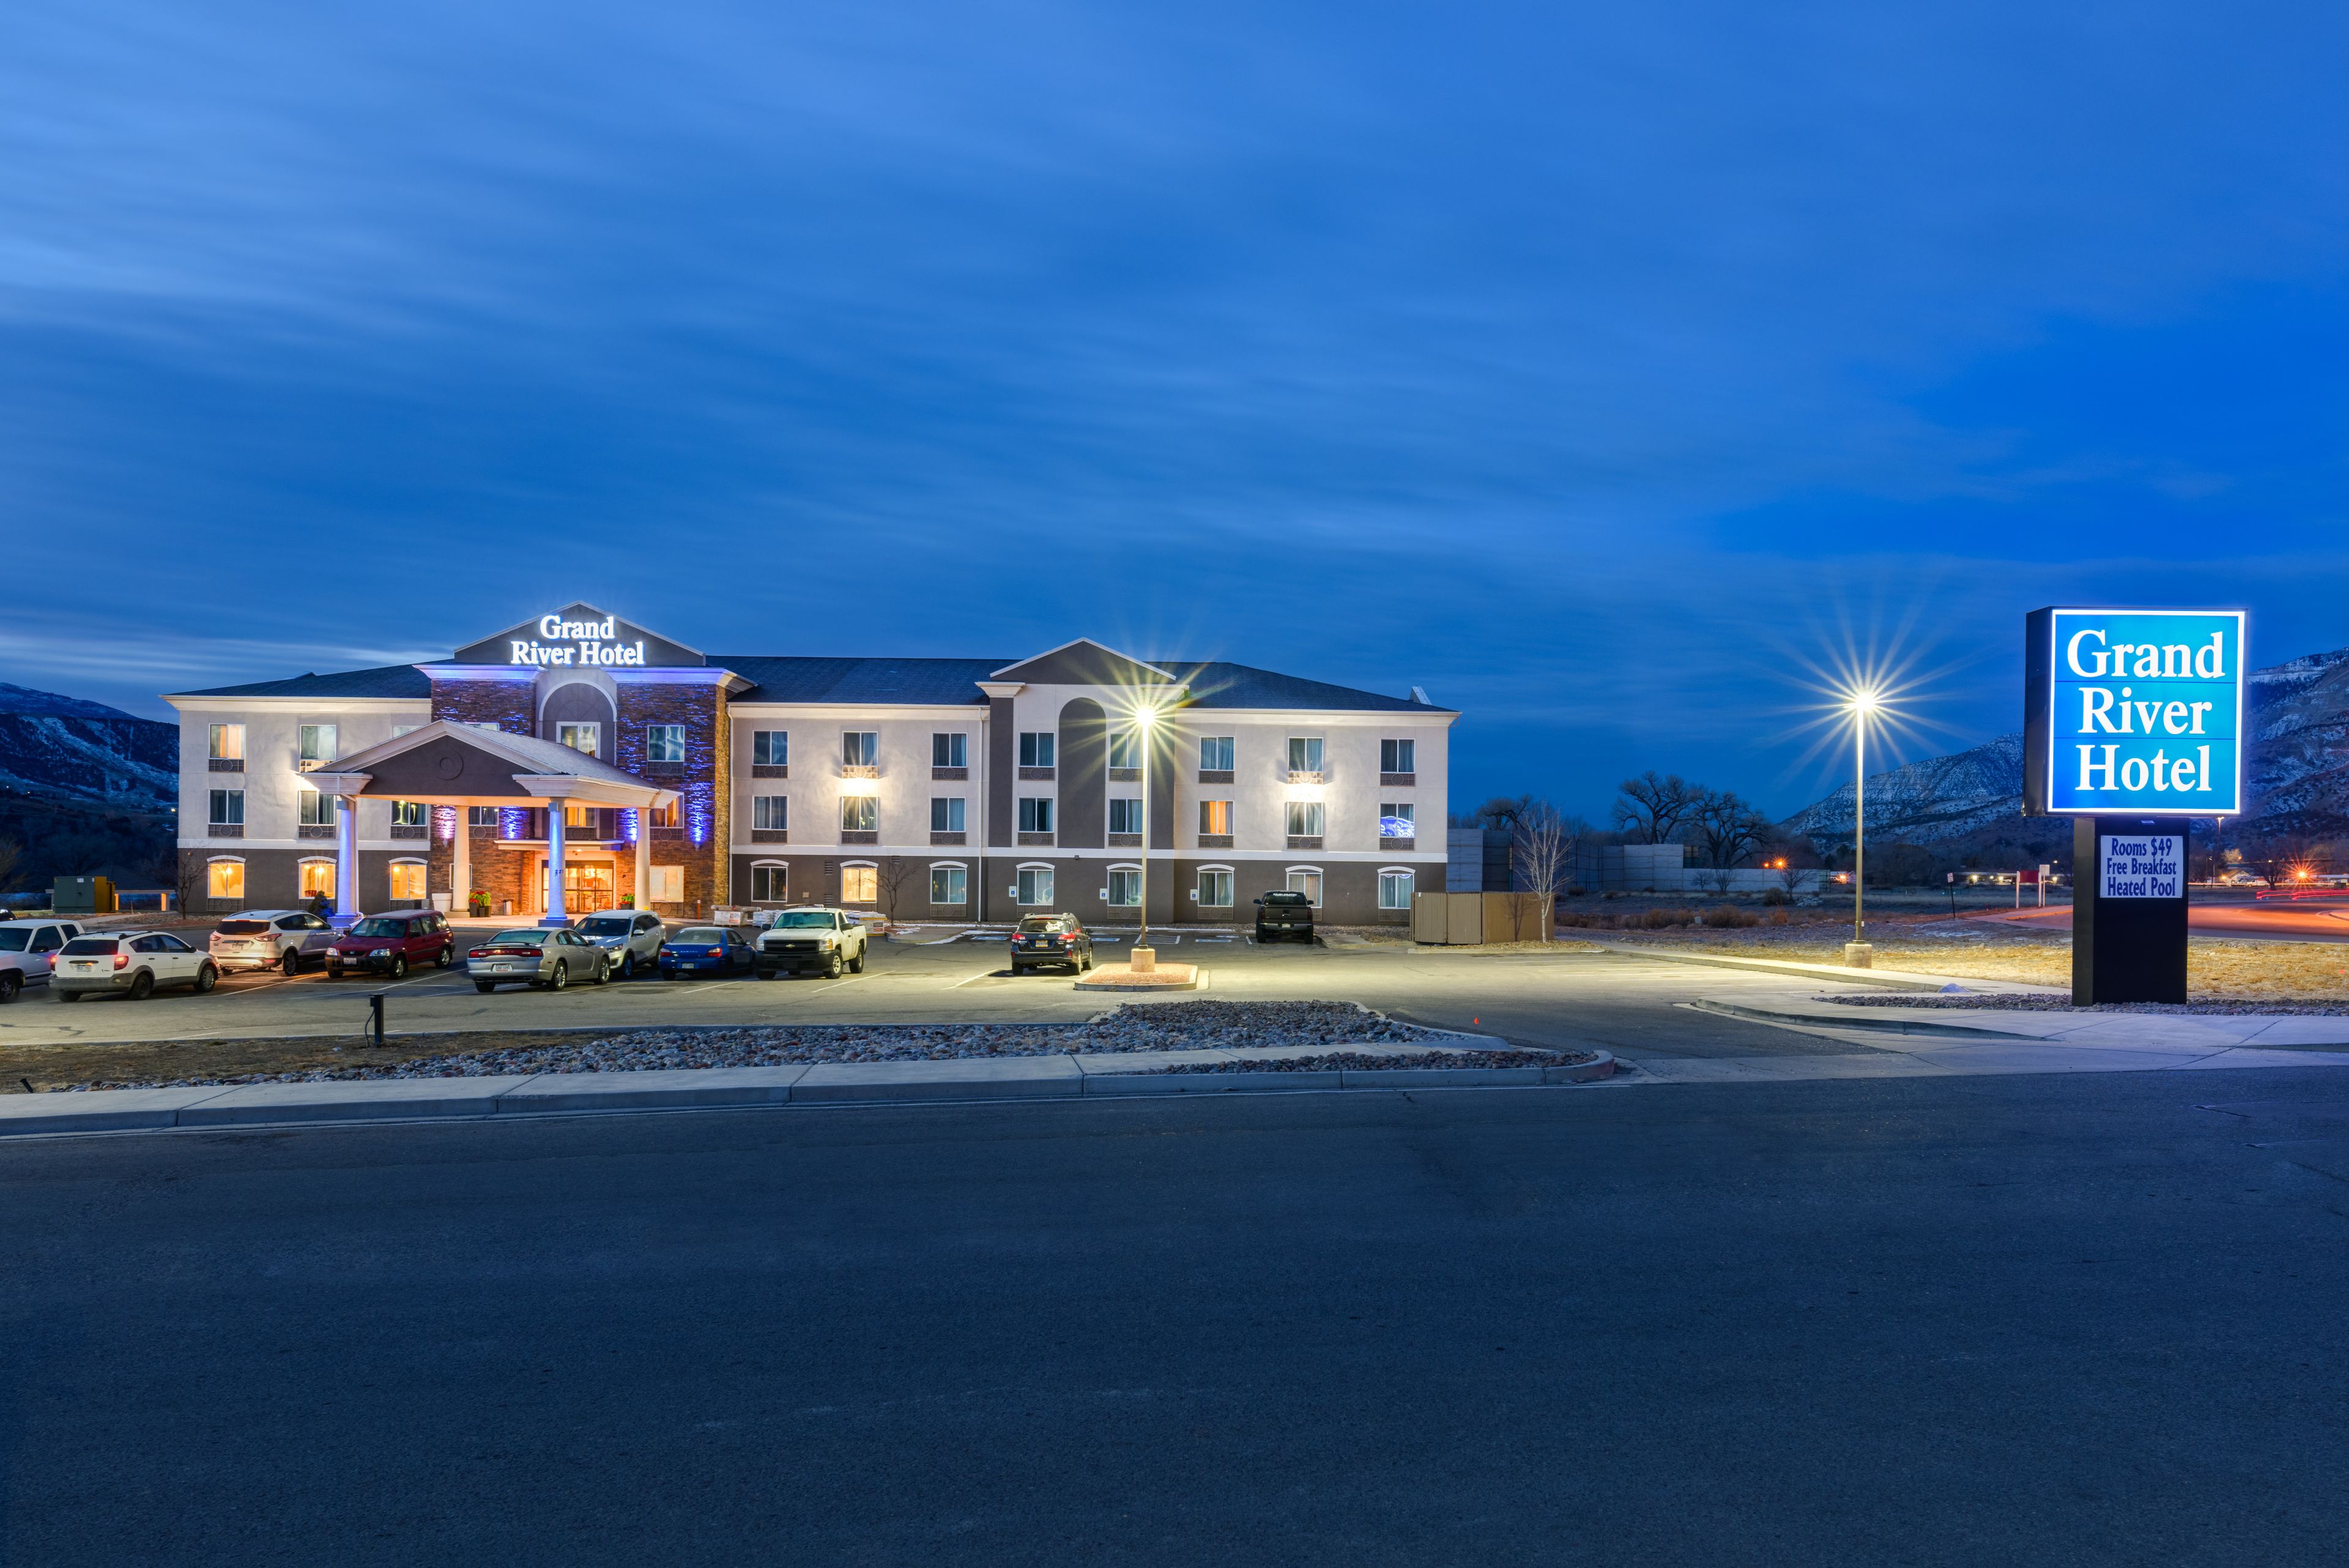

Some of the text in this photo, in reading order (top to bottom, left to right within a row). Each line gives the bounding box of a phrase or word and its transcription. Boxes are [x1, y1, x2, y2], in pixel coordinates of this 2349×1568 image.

[540, 615, 615, 639] Grand
[511, 641, 645, 664] River Hotel
[2067, 630, 2226, 678] Grand
[2077, 686, 2213, 735] River
[2075, 744, 2213, 792] Hotel
[2111, 837, 2172, 858] Rooms $49
[2107, 857, 2176, 875] Free Breakfast
[2107, 877, 2176, 896] Heated Pool
